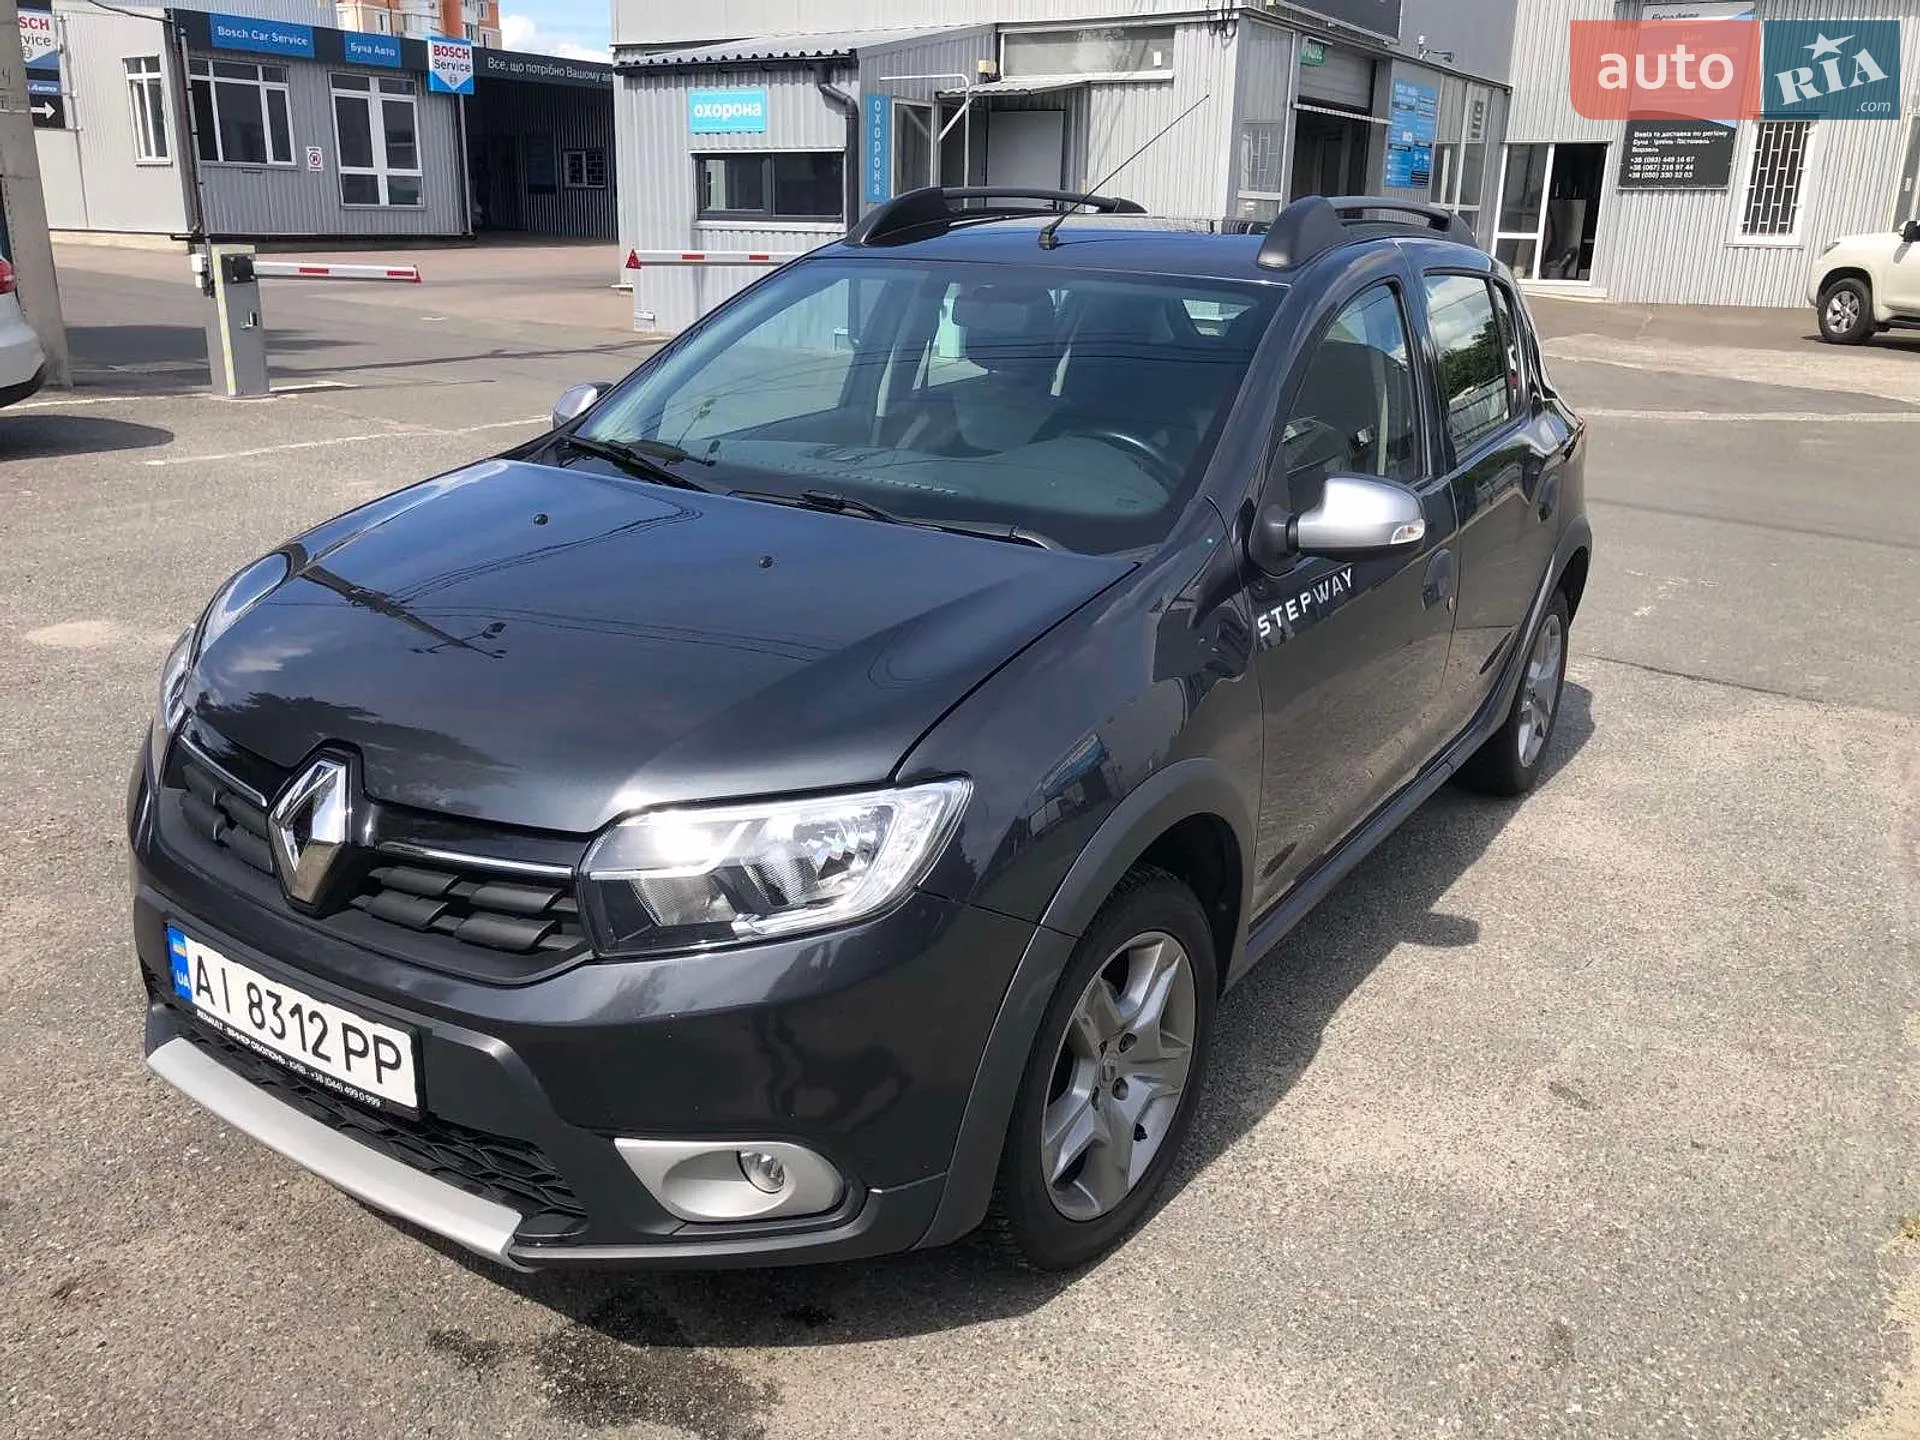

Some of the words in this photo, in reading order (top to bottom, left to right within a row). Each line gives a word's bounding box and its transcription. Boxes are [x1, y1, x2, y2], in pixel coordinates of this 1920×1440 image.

[19, 15, 50, 31] SCH
[21, 33, 51, 47] vice
[217, 25, 248, 38] Bosch
[251, 30, 268, 41] Car
[271, 32, 308, 46] Service
[350, 42, 371, 54] Буча
[374, 45, 395, 57] Авто
[433, 45, 470, 59] BOSCH
[434, 59, 472, 73] Service
[488, 57, 508, 71] Все,
[510, 62, 524, 73] що
[526, 63, 565, 77] потрібно
[566, 66, 600, 82] Вашому
[694, 100, 762, 120] охорона
[872, 99, 882, 195] охорона
[1257, 566, 1353, 638] STEPWAY
[176, 969, 191, 990] UA
[195, 955, 230, 1013] AI
[246, 981, 332, 1063] 8312
[342, 1023, 402, 1084] PP
